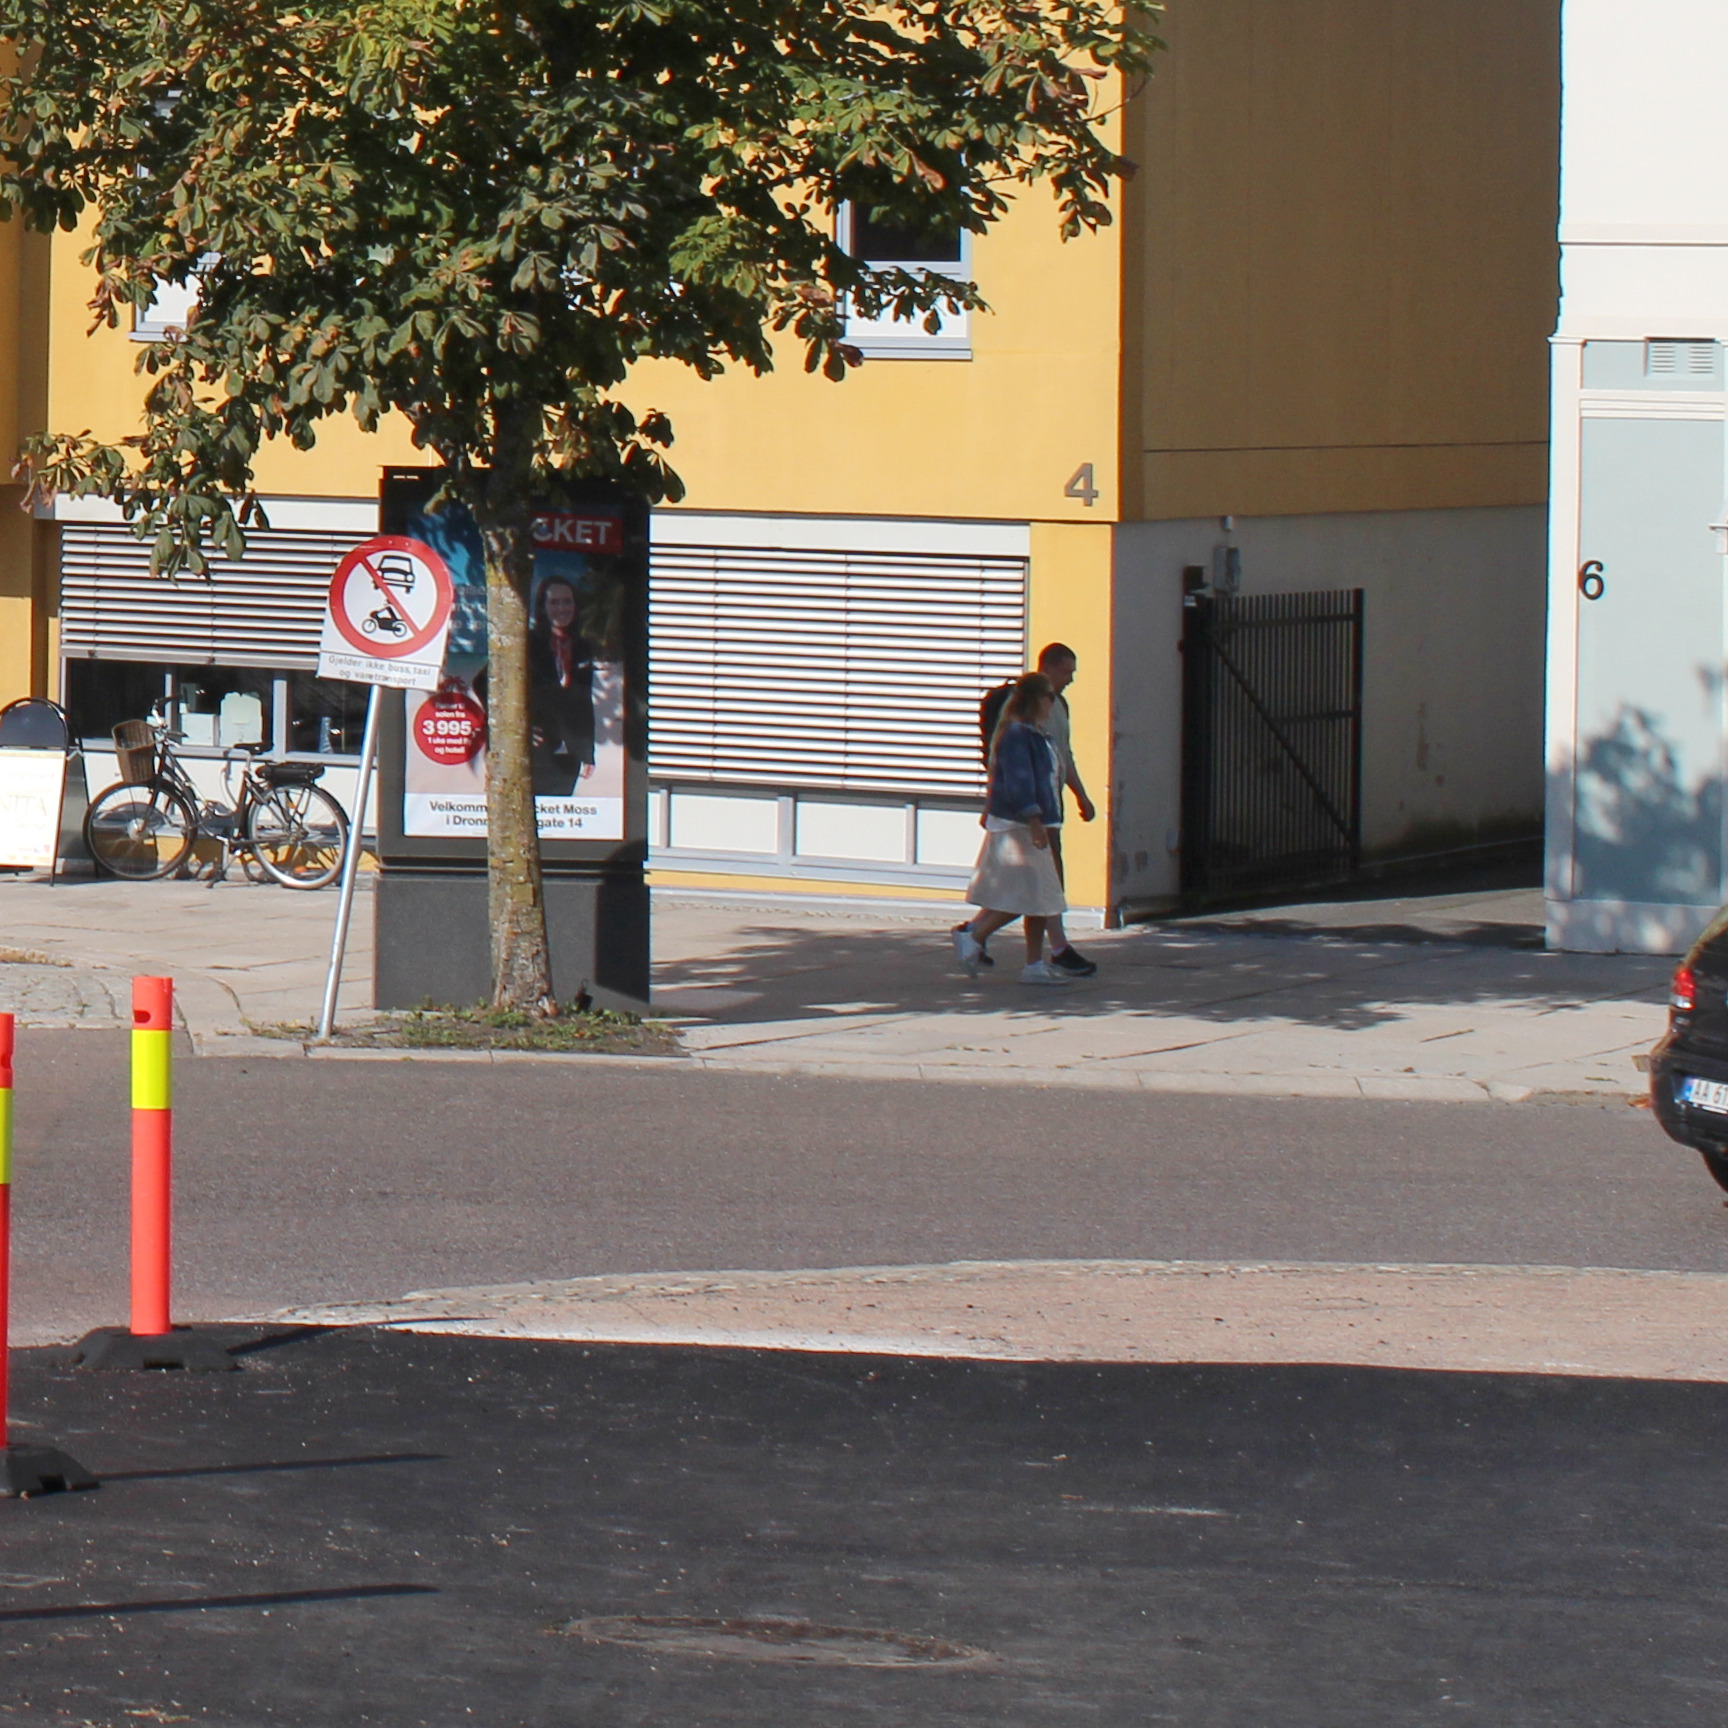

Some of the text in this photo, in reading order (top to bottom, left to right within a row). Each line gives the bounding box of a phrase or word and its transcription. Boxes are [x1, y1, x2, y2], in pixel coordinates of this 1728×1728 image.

[1063, 462, 1099, 507] 4
[531, 518, 613, 545] CKET
[1578, 559, 1604, 601] 6
[328, 654, 362, 667] Gjelder
[365, 660, 385, 670] ikke
[413, 666, 432, 676] taxi
[339, 669, 417, 686] og varetransport
[429, 800, 599, 815] Velkomm cket Moss
[569, 817, 584, 828] 14
